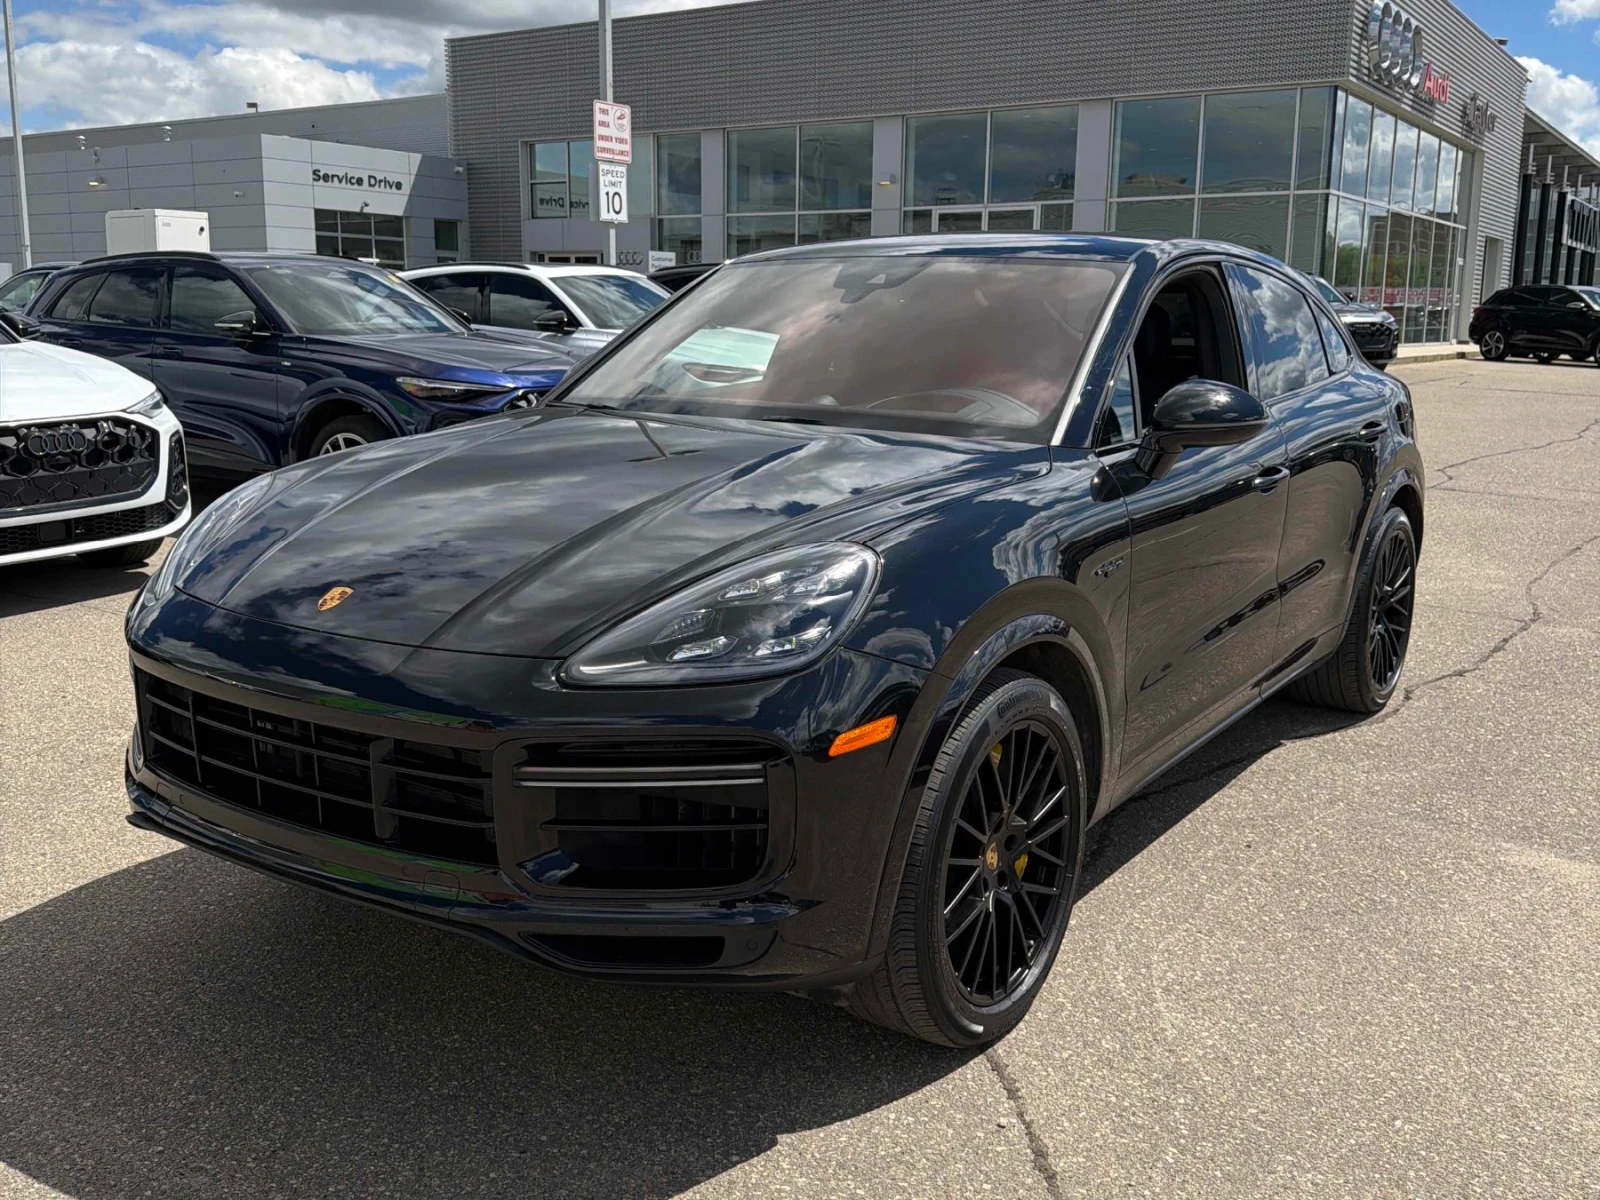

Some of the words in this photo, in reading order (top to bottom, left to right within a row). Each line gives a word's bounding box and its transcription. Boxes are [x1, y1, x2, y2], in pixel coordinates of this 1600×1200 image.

[1422, 62, 1449, 105] Audi
[598, 107, 610, 116] THIS
[598, 120, 610, 128] AREA
[598, 134, 613, 143] UNDER
[614, 136, 628, 145] VIDEO
[596, 146, 629, 157] SURVEILLANCE
[601, 168, 625, 179] SPEED
[312, 169, 363, 187] Service
[367, 174, 403, 191] Drive
[603, 179, 623, 189] LIMIT
[605, 190, 623, 215] 10
